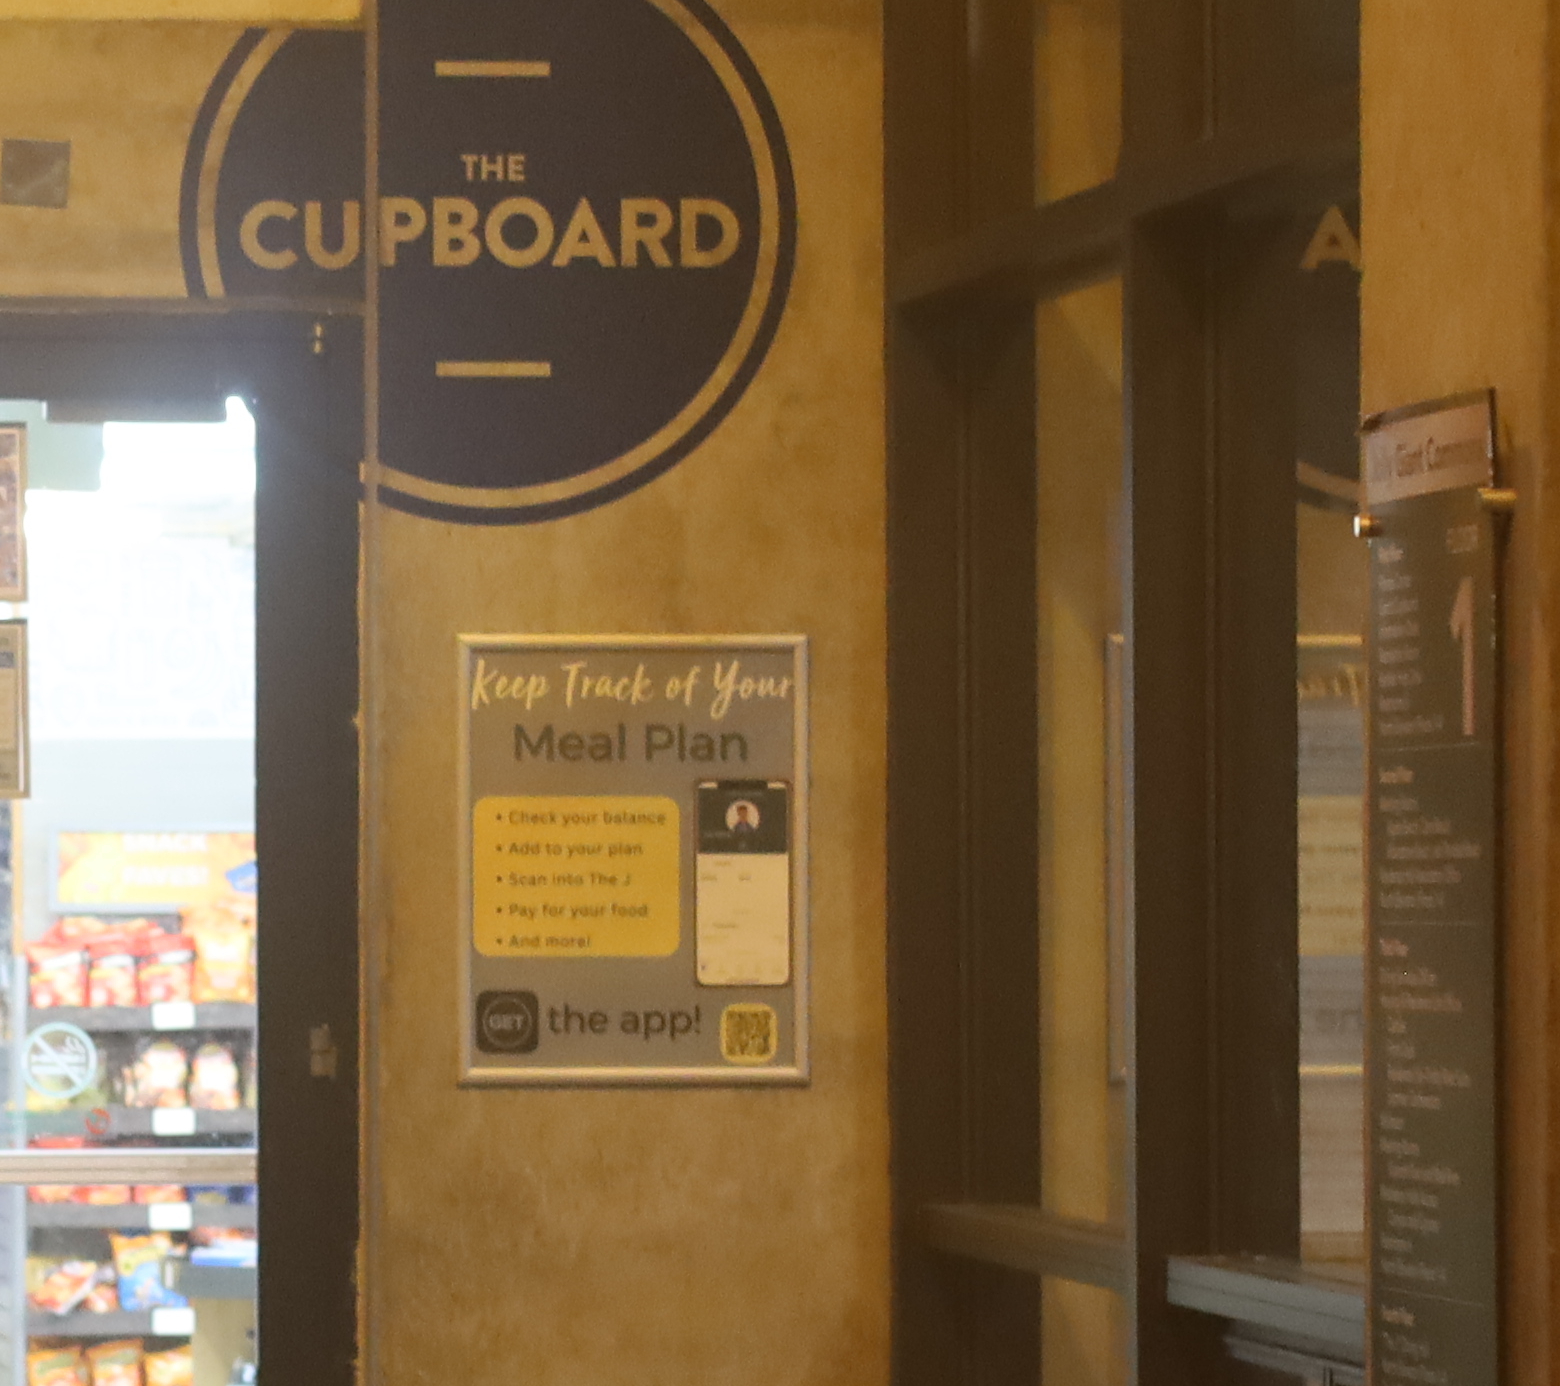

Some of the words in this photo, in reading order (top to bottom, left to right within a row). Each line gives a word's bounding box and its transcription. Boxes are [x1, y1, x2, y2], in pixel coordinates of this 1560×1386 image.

[461, 155, 526, 182] THE
[239, 196, 741, 270] CUPBOARD
[1449, 576, 1476, 736] 1
[472, 659, 549, 710] Keep
[562, 660, 654, 708] Track
[665, 665, 701, 707] of
[711, 659, 794, 720] Your
[513, 723, 626, 763] Meal
[644, 723, 748, 763] Plan
[508, 809, 557, 825] Check
[562, 812, 598, 827] your
[603, 810, 666, 825] balance
[122, 832, 206, 852] SNACK
[508, 842, 540, 855] Add
[546, 842, 562, 855] to
[566, 844, 602, 858] your
[608, 842, 643, 858] plan
[508, 872, 547, 886] Scan
[552, 872, 584, 886] into
[589, 872, 618, 886] The
[508, 903, 536, 919] Pay
[542, 902, 564, 917] for
[569, 905, 606, 919] your
[611, 902, 649, 917] food
[508, 934, 540, 948] And
[489, 1013, 525, 1030] GET
[548, 1002, 609, 1035] the
[620, 1004, 701, 1041] app!
